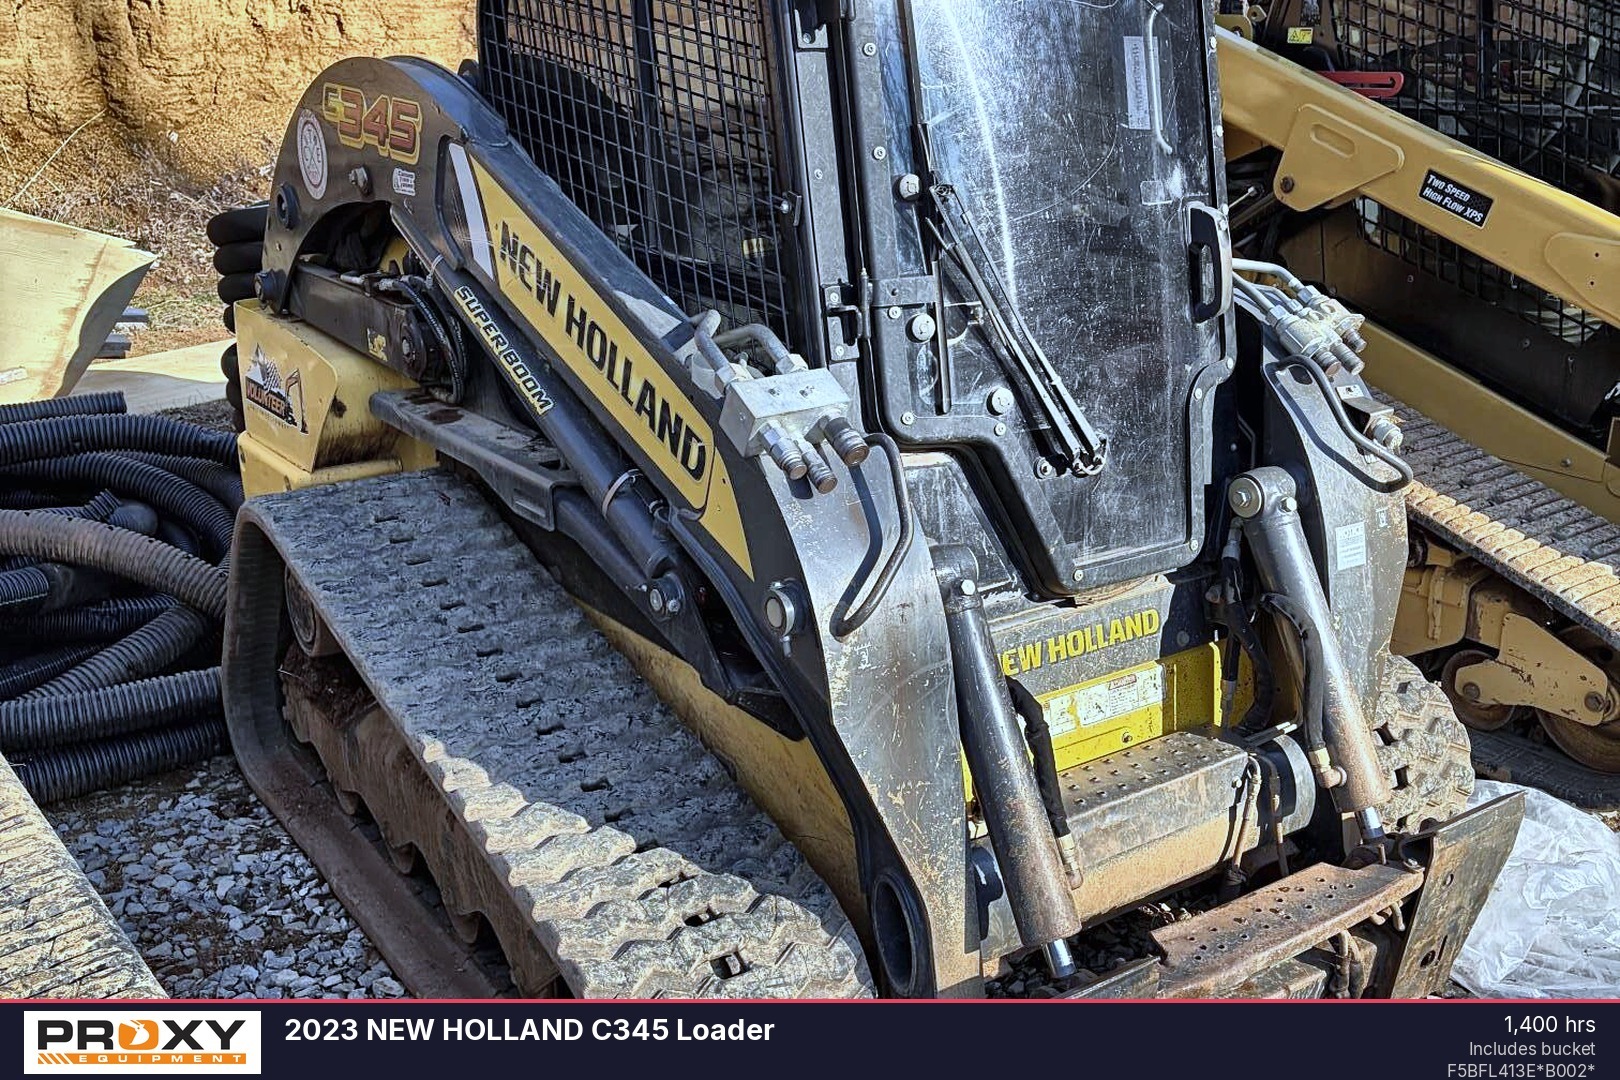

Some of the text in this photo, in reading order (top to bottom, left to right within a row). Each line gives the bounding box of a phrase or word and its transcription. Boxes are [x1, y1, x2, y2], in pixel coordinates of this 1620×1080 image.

[1463, 207, 1484, 223] XPS
[454, 285, 555, 416] SUPER BOOM
[499, 220, 706, 482] NEW HOLLAND
[997, 608, 1161, 677] EW HOLLAND
